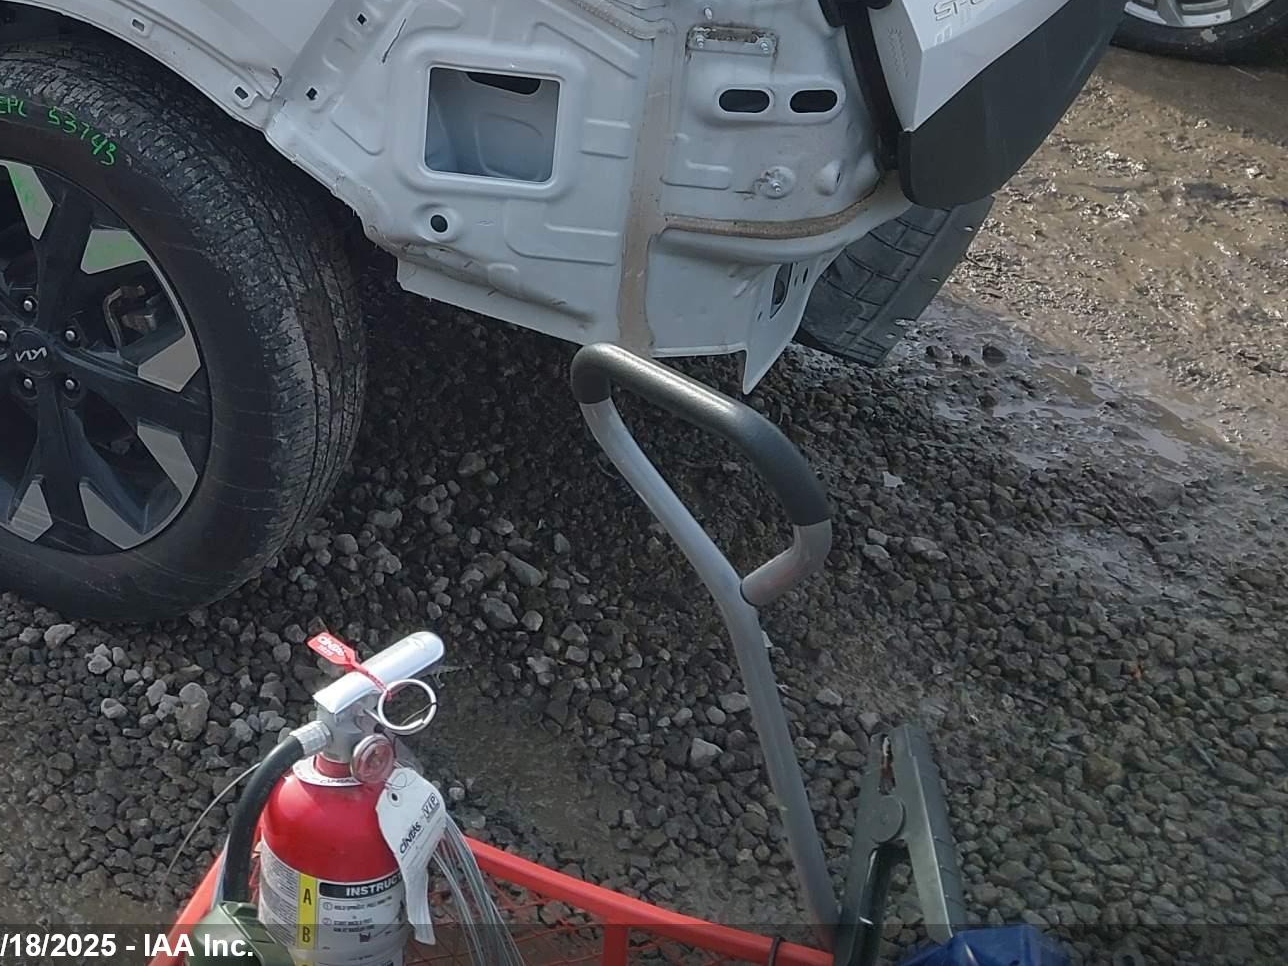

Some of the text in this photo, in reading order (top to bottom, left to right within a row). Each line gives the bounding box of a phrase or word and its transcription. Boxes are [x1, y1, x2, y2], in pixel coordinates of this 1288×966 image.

[423, 794, 437, 819] VIP
[303, 888, 312, 905] A
[302, 926, 311, 943] B
